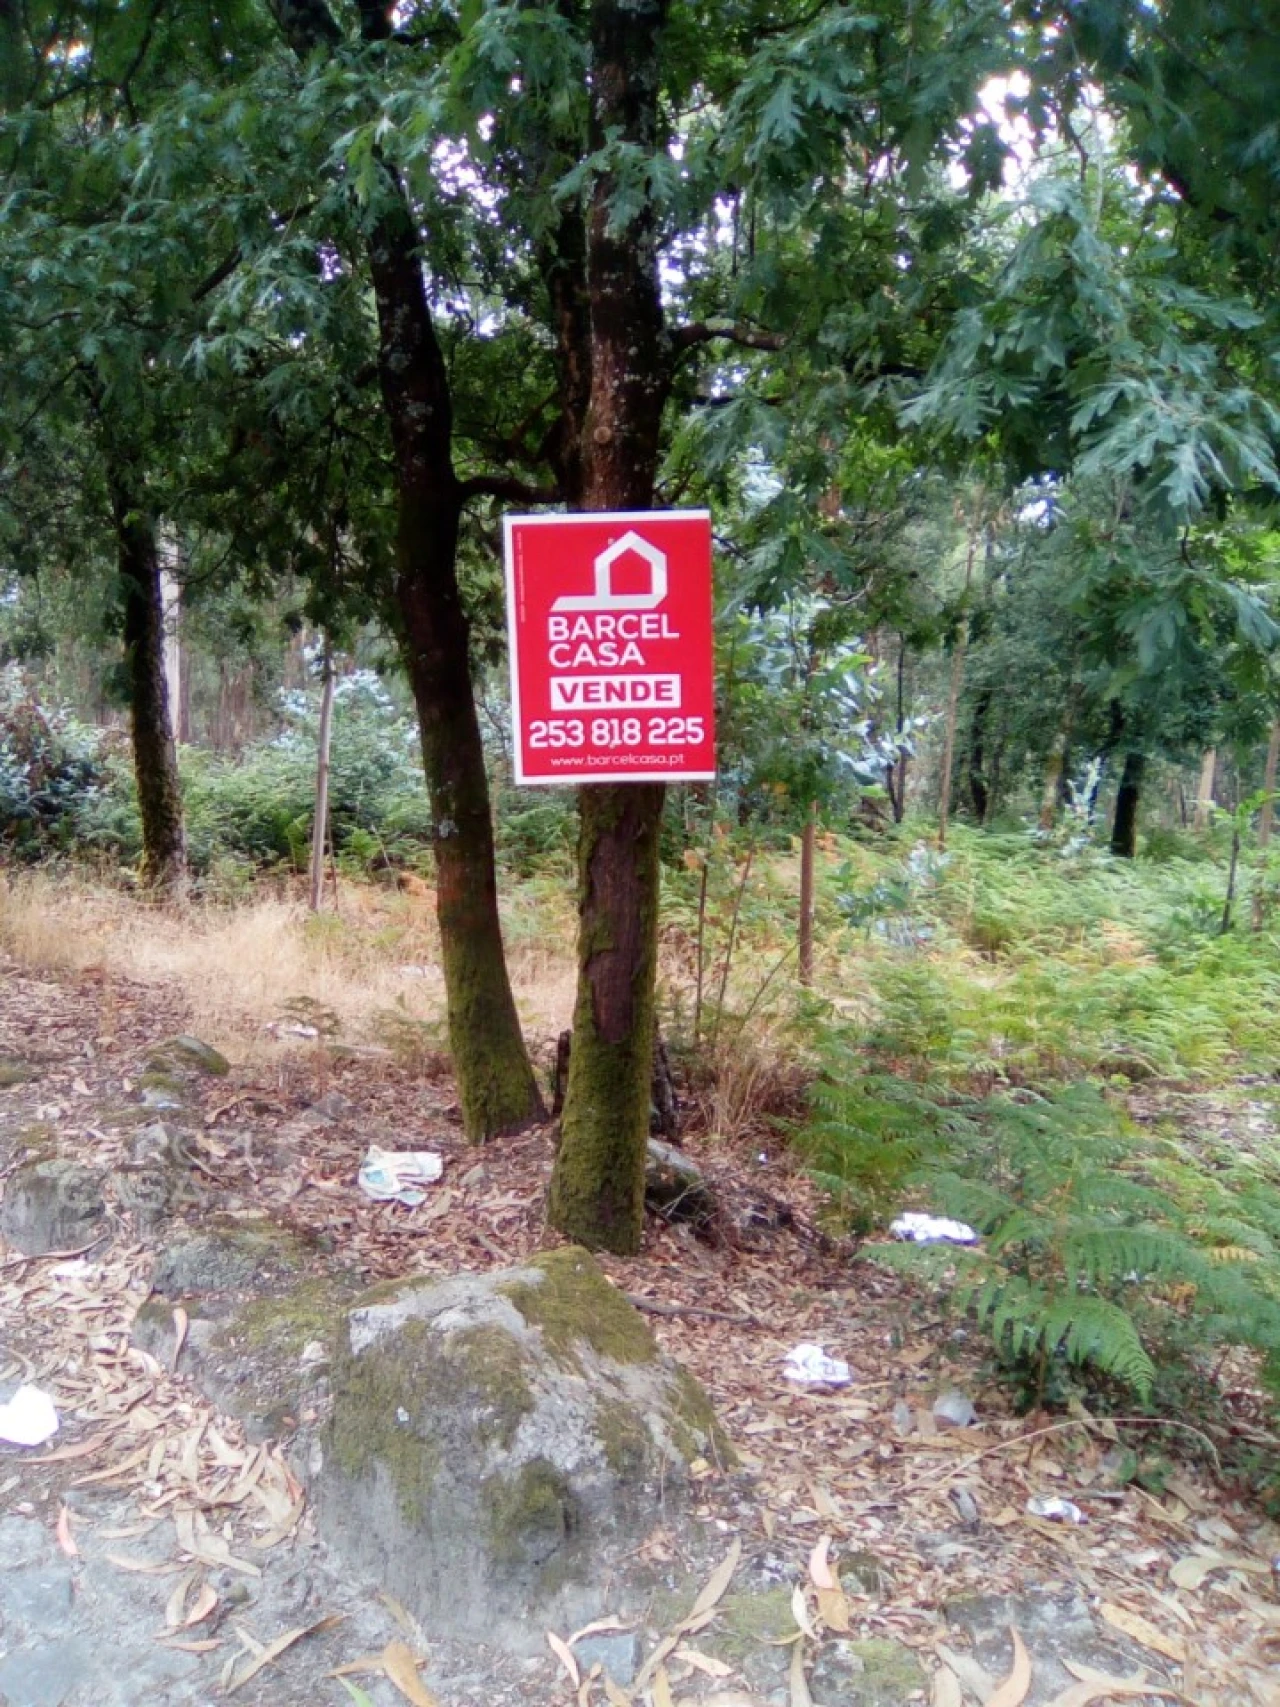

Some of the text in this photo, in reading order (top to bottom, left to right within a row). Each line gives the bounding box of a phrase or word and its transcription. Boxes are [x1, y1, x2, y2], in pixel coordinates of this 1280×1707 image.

[548, 613, 680, 641] BARCEL
[548, 641, 646, 668] CASA
[556, 680, 674, 703] VENDE
[529, 716, 705, 748] 253 818 225
[550, 753, 684, 767] www.barcelcasa.pt
